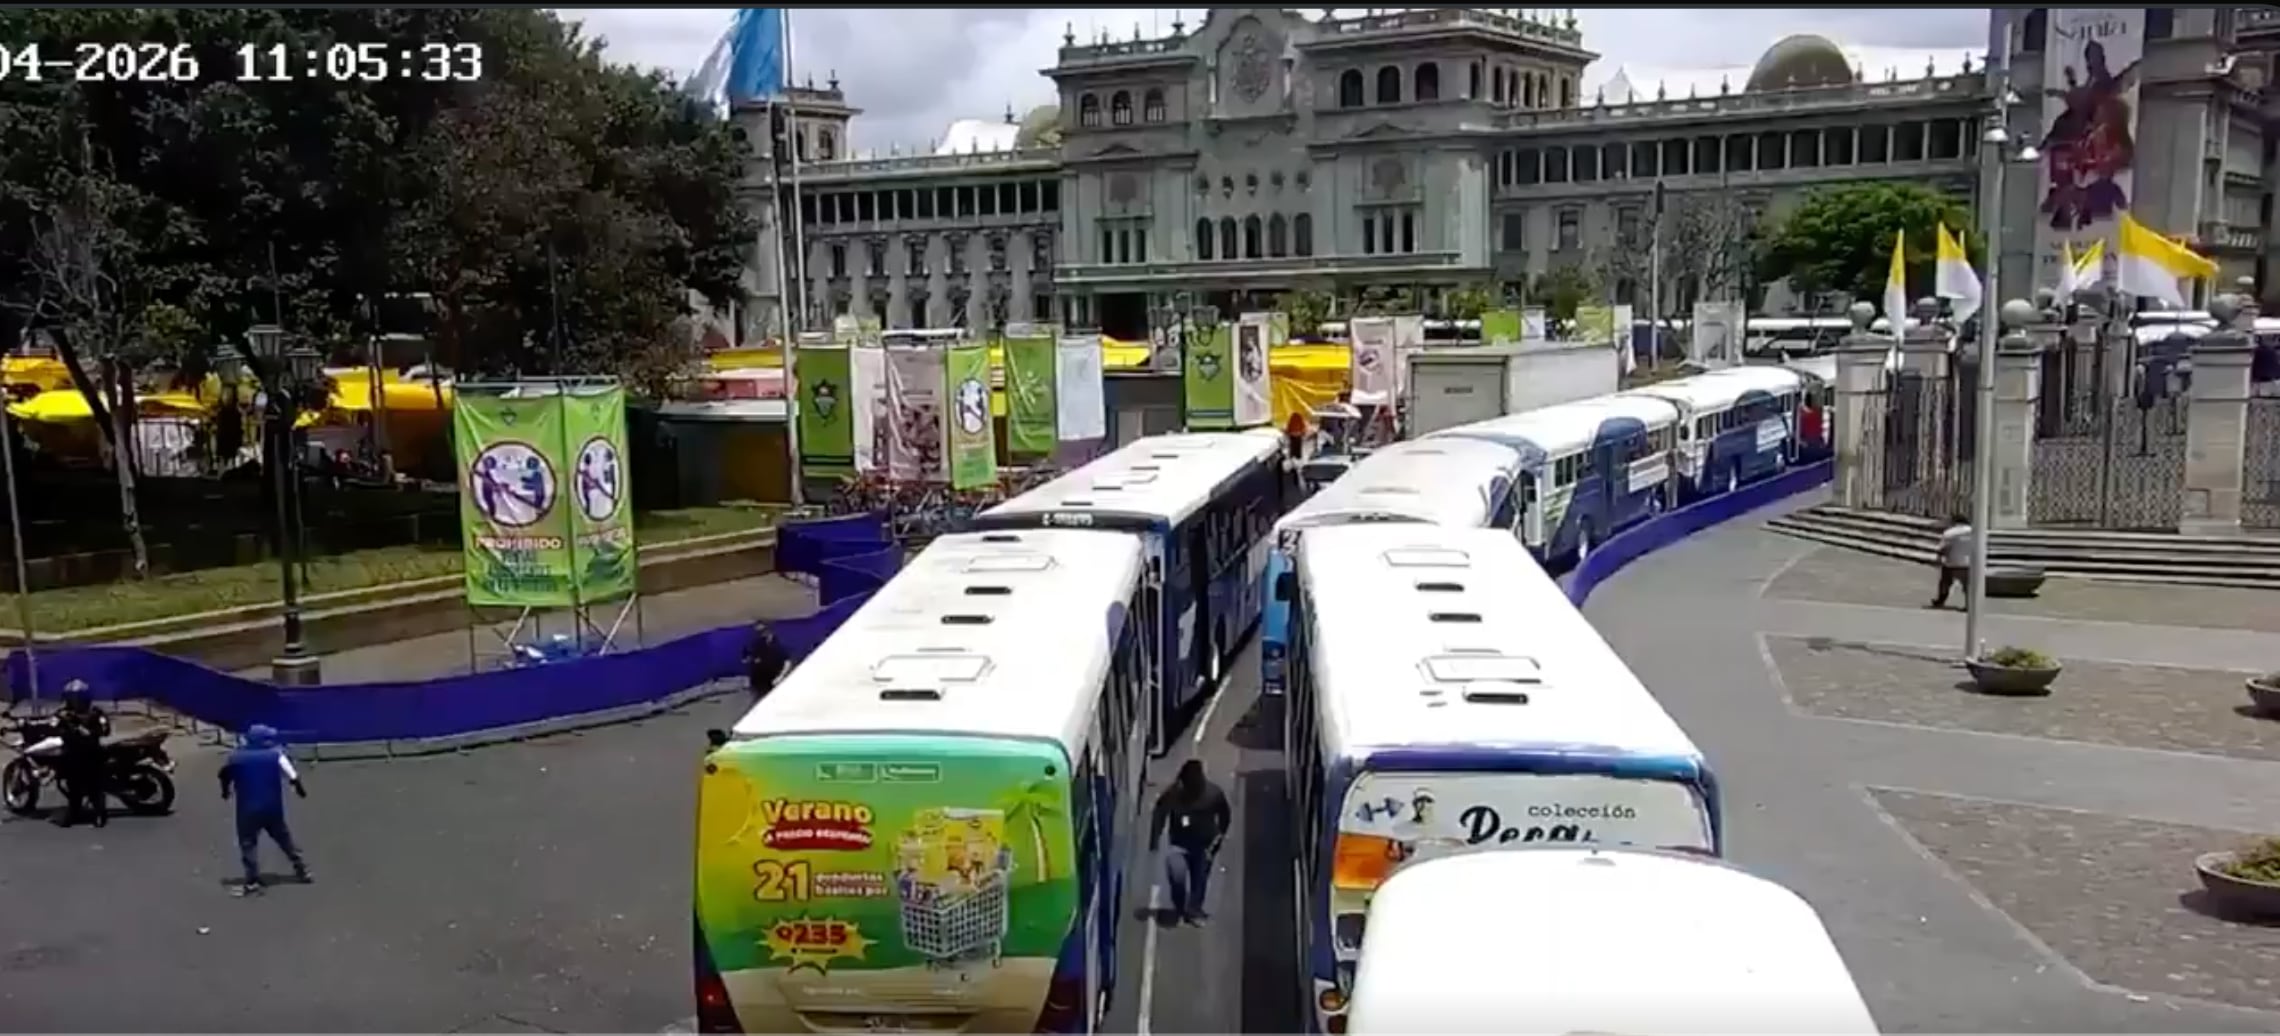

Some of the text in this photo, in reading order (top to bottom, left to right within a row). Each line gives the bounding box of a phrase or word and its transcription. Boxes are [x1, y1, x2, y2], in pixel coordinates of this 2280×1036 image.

[762, 798, 874, 824] Verano
[1528, 803, 1636, 819] colección
[754, 858, 811, 902] 21
